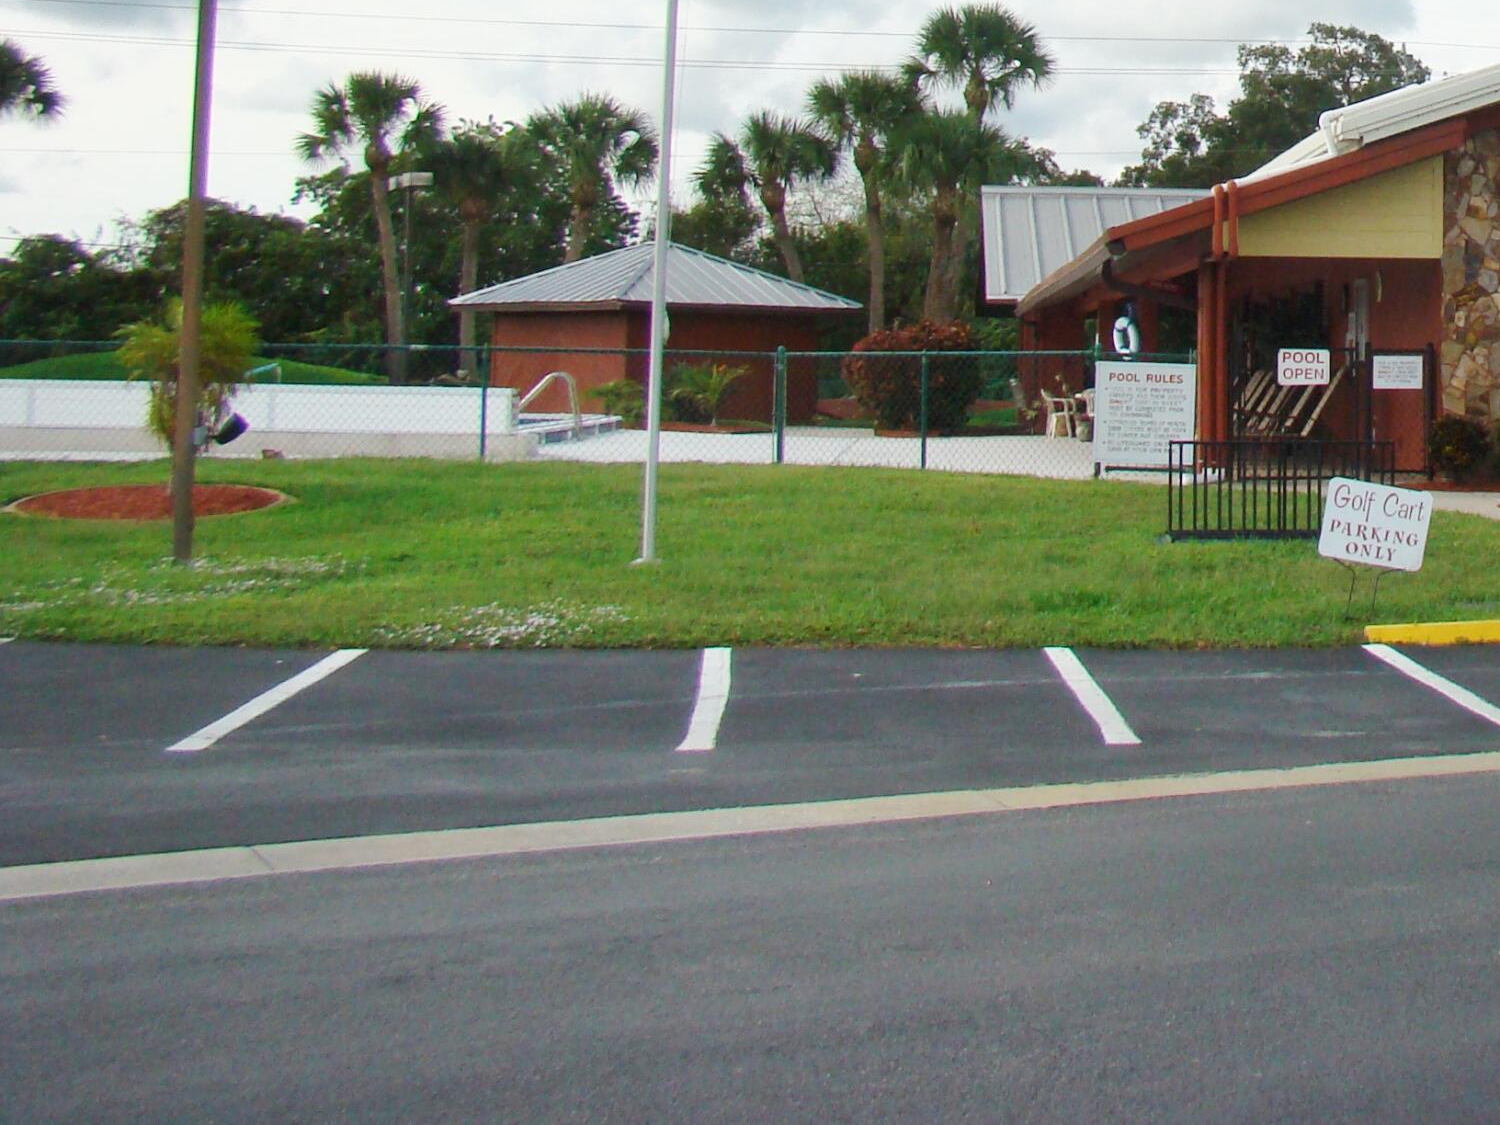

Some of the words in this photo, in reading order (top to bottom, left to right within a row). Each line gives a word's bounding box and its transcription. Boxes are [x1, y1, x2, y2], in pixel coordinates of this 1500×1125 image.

[1282, 351, 1324, 363] POOL
[1108, 372, 1140, 382] POOL
[1146, 373, 1184, 384] RULES
[1283, 367, 1324, 379] OPEN
[1334, 483, 1377, 523] Golf
[1383, 492, 1425, 522] Cart
[1330, 519, 1419, 547] PARKING
[1345, 541, 1397, 562] ONLY
